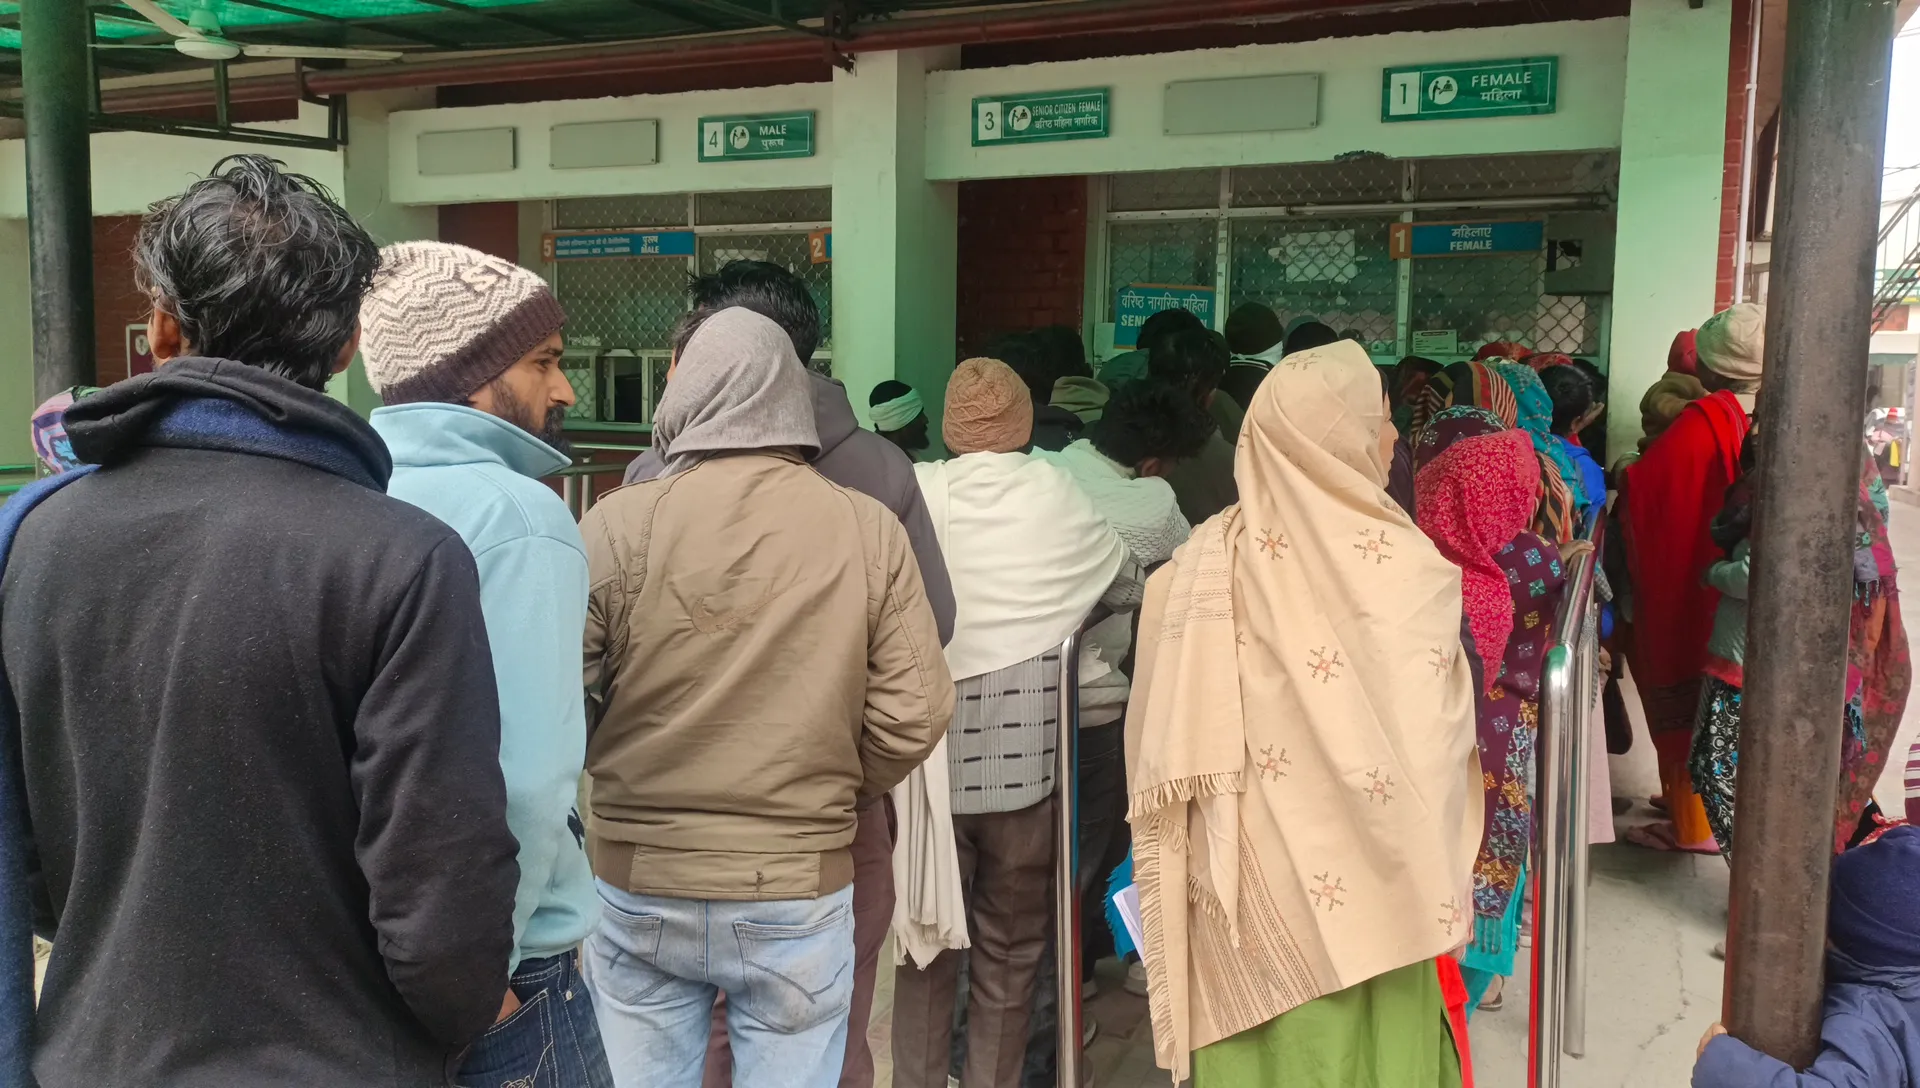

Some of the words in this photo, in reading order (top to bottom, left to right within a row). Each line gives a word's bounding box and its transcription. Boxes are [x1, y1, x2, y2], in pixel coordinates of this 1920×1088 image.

[1471, 71, 1532, 88] FEMALE
[1400, 83, 1407, 105] 1
[1480, 87, 1522, 102] महिला
[1032, 104, 1053, 117] SENIOR
[1053, 103, 1076, 115] CITIZEN
[1078, 100, 1101, 113] FEMALE
[984, 111, 995, 131] 3
[1053, 116, 1072, 129] महिला
[1074, 114, 1098, 127] नागरिक
[759, 124, 787, 136] MALE
[709, 130, 718, 148] 4
[1451, 224, 1493, 239] महिलाएं
[543, 239, 552, 257] 5
[812, 238, 823, 258] 2
[1395, 229, 1406, 253] 1
[1449, 240, 1493, 251] FEMALE
[640, 246, 660, 254] MALE
[1121, 290, 1145, 309] वरिष्ठ
[1147, 292, 1180, 310] नागरिक
[1182, 293, 1209, 314] महिला
